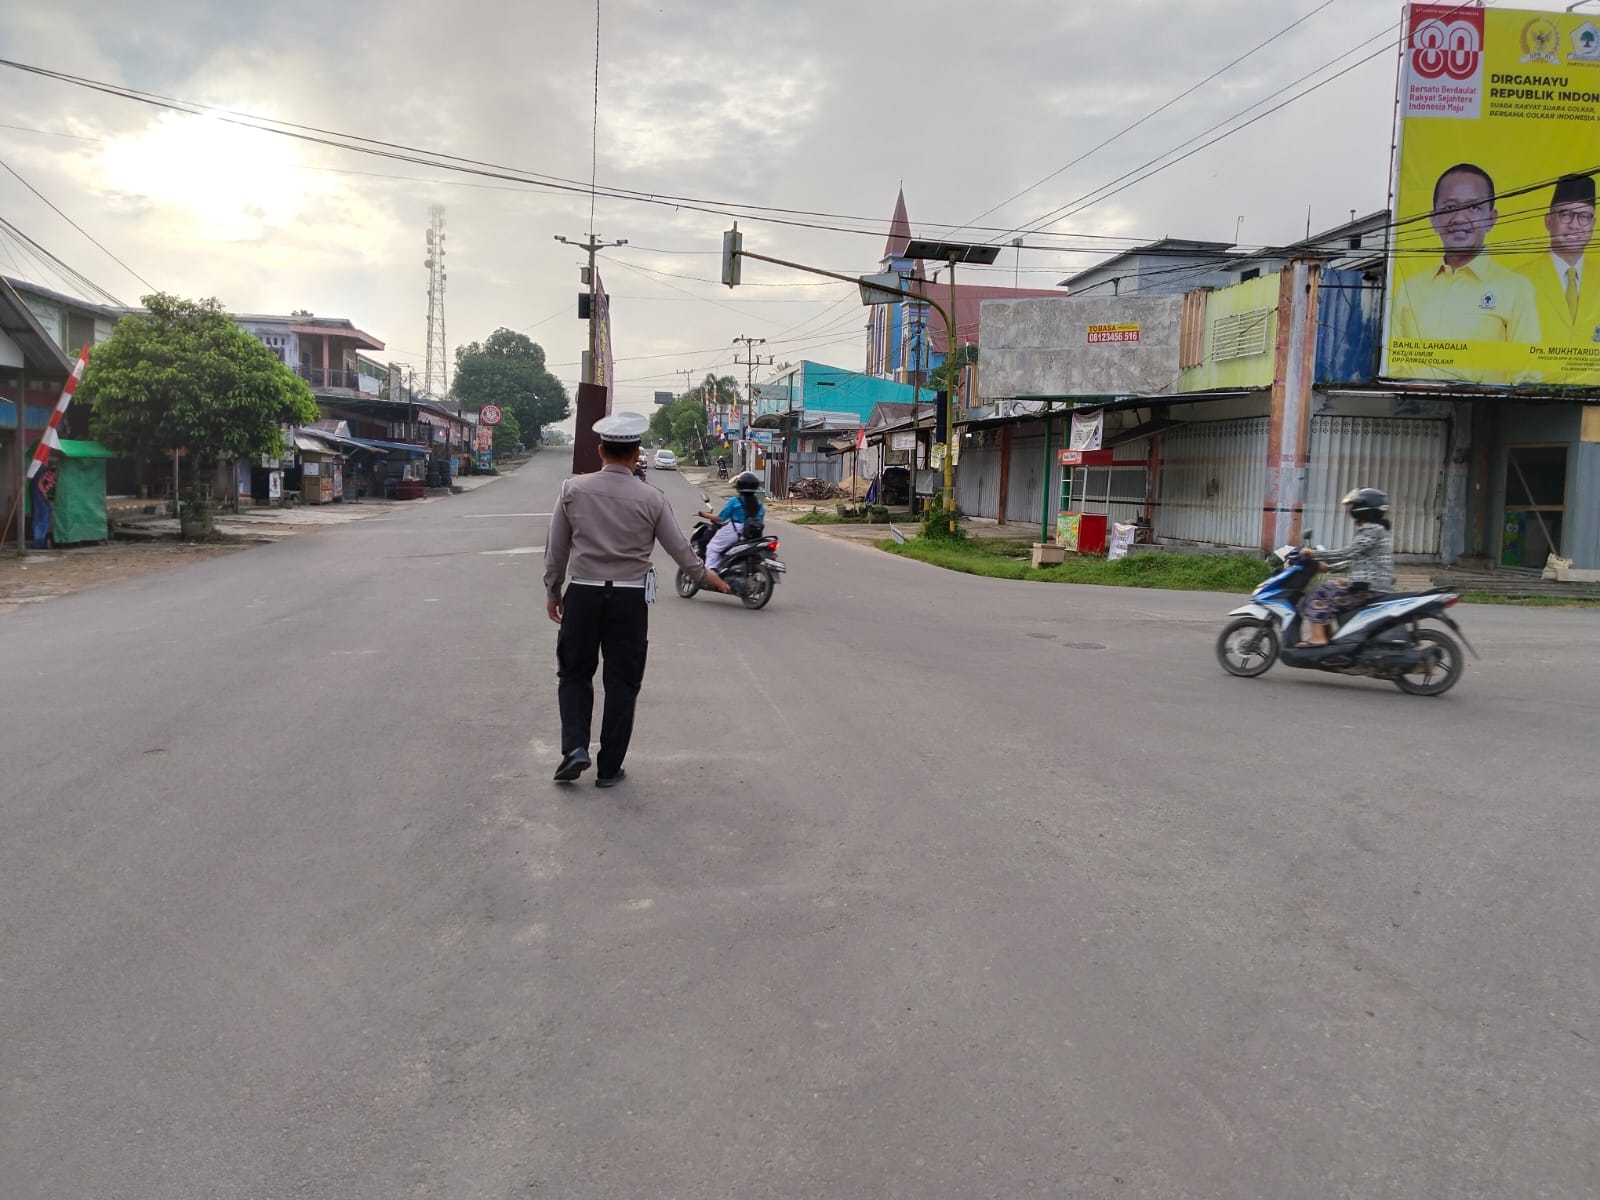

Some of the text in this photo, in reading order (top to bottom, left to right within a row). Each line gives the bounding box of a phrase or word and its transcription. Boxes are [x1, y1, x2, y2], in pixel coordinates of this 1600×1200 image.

[1490, 74, 1568, 87] DIRGAHAYU
[1410, 85, 1476, 94] Bersatu Berdaulat
[1409, 94, 1472, 103] Rakyat Sejahtera
[1490, 88, 1600, 103] REPUBLIK INDON
[1409, 103, 1464, 112] Indonesia Maju
[1489, 110, 1524, 118] BERSAMA
[1556, 113, 1595, 121] INDONESIA
[1088, 324, 1116, 332] TOBASA
[1392, 341, 1468, 351] BAHLIL LAHADALIA
[1529, 346, 1546, 355] Drs.
